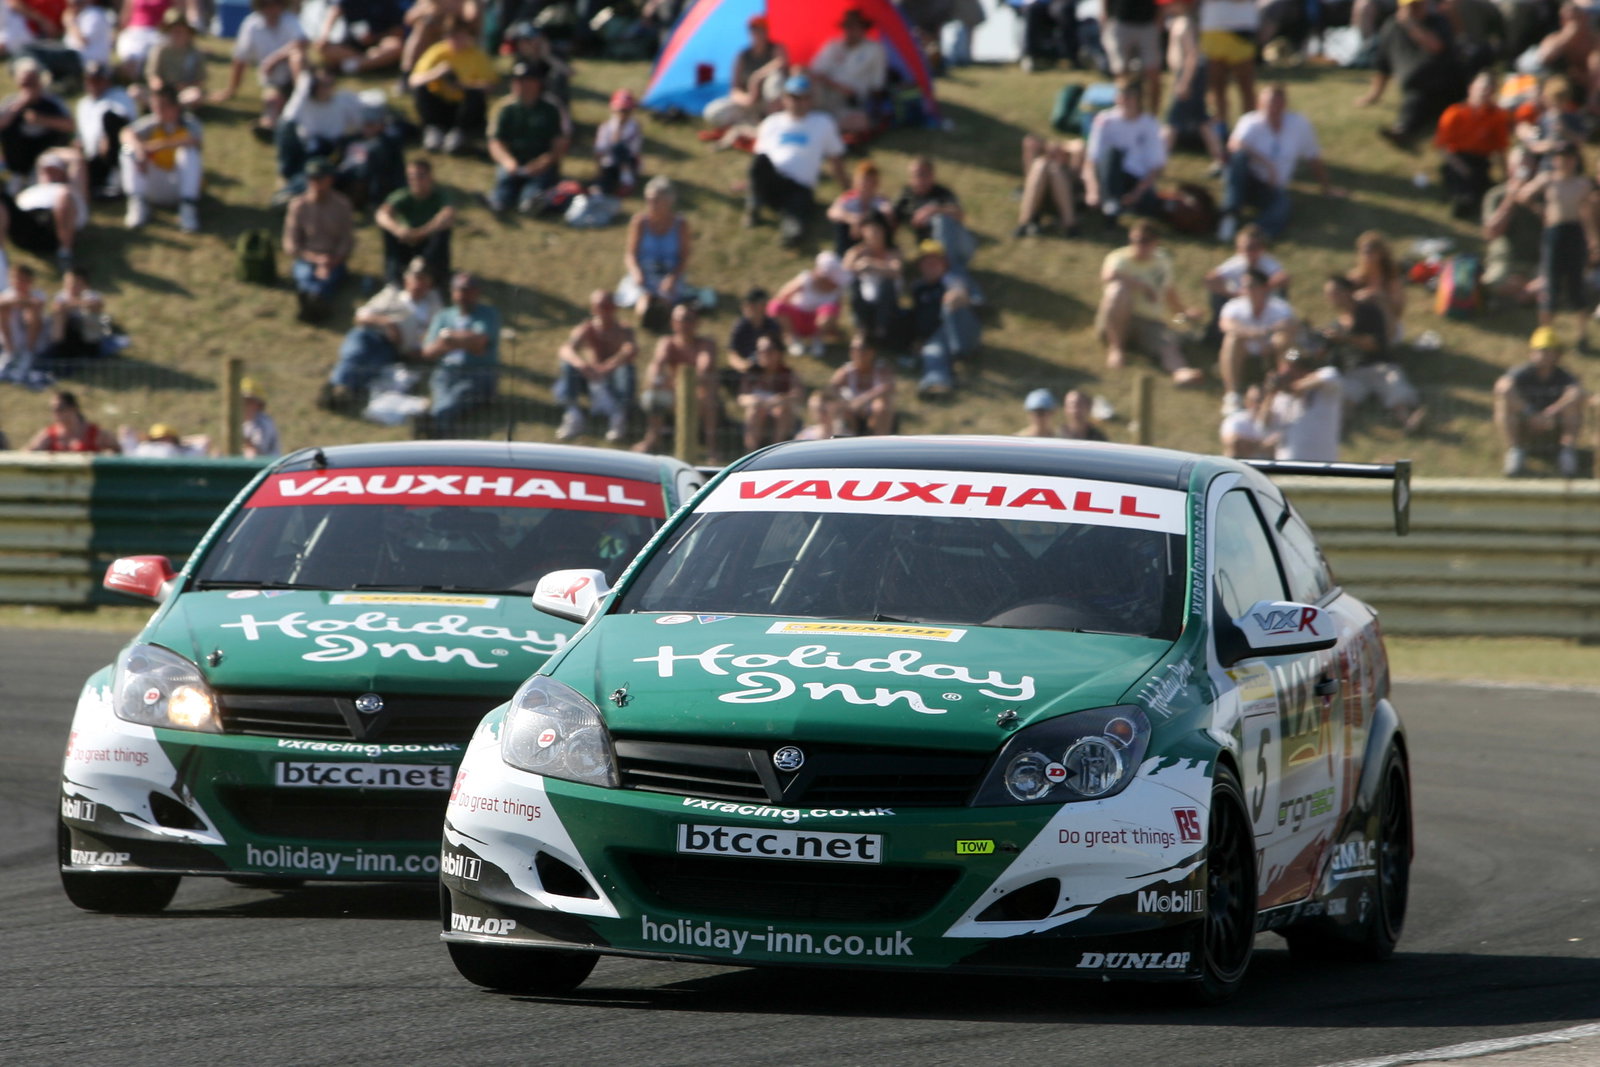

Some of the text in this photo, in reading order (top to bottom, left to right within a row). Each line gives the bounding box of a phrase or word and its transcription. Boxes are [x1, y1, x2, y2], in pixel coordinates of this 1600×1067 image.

[278, 474, 646, 507] VAUXHALL
[740, 480, 1160, 519] VAUXHALL
[221, 611, 568, 655] Holiday
[1252, 607, 1320, 636] VXR
[301, 634, 499, 669] Inn
[633, 643, 1036, 701] Holiday
[718, 671, 948, 714] Inn
[1137, 675, 1181, 718] Holiday
[85, 749, 110, 765] great
[114, 747, 149, 767] things
[277, 739, 460, 757] vxracing.co.uk
[282, 762, 445, 787] btcc.net
[1252, 727, 1271, 824] 5
[470, 796, 499, 813] great
[503, 798, 541, 821] things
[682, 797, 896, 824] vxracing.co.uk
[1059, 827, 1176, 849] Do great things
[1173, 809, 1202, 842] RS
[685, 824, 875, 860] btcc.net
[960, 842, 988, 853] TOW
[1331, 839, 1377, 870] GMAC
[70, 849, 131, 866] UNLOP
[1137, 889, 1192, 913] Mobil
[451, 912, 517, 935] UNLOP
[641, 914, 914, 956] holiday-inn.co.uk
[1075, 952, 1191, 969] DUNLOP
